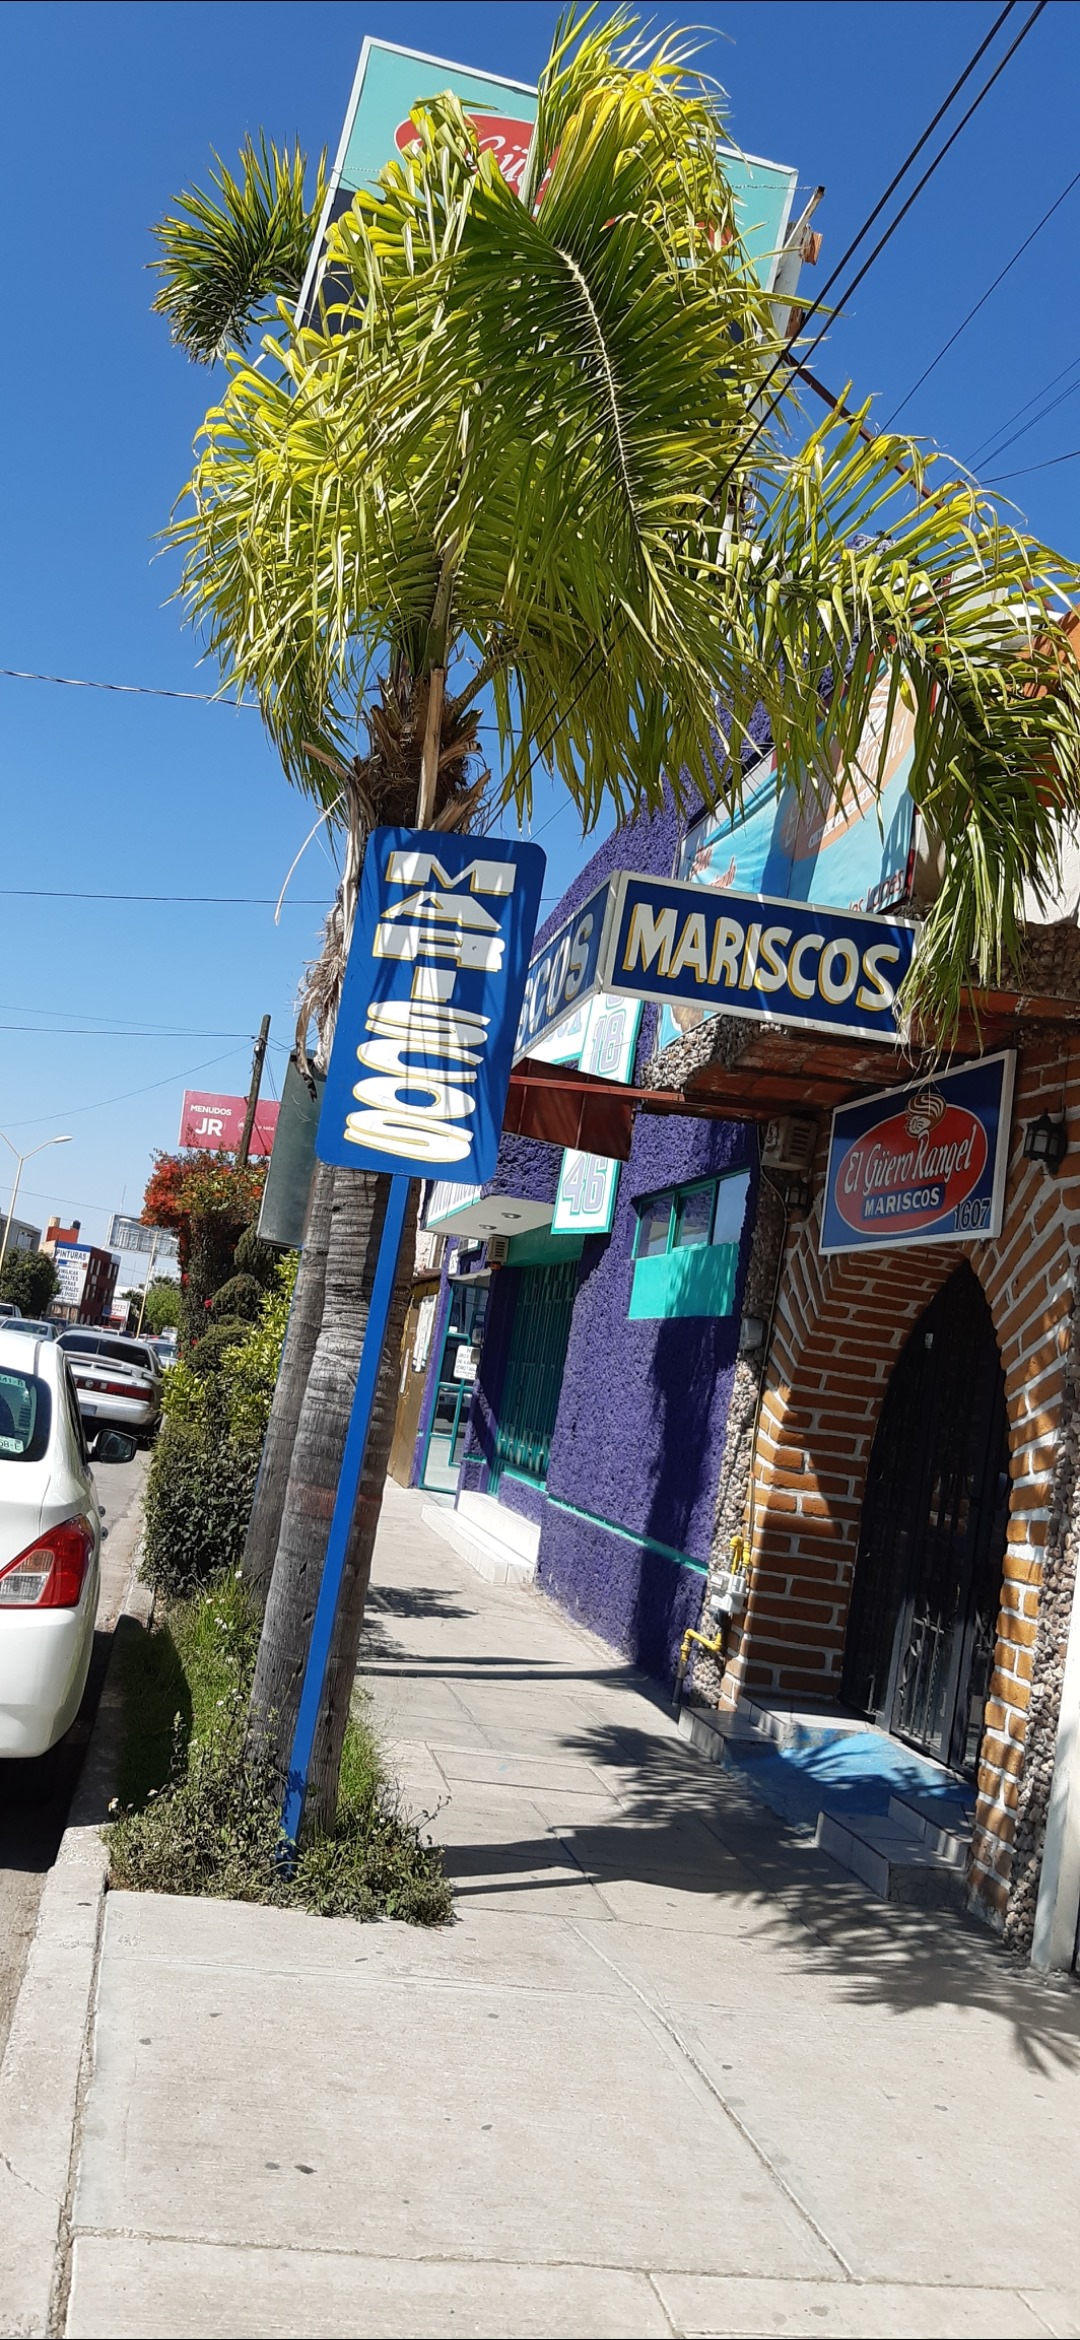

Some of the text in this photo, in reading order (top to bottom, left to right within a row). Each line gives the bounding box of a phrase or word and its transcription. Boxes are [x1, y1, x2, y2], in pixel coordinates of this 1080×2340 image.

[622, 902, 900, 1011] MARISCOS
[343, 851, 517, 1163] MARISCOS
[190, 1104, 232, 1116] MENUDOS
[195, 1117, 223, 1136] JR
[844, 1124, 977, 1197] El Güero Rangel
[562, 1153, 608, 1216] 46
[864, 1188, 940, 1217] MARISCOS
[953, 1198, 991, 1231] 1607
[56, 1248, 87, 1261] PINTURAS
